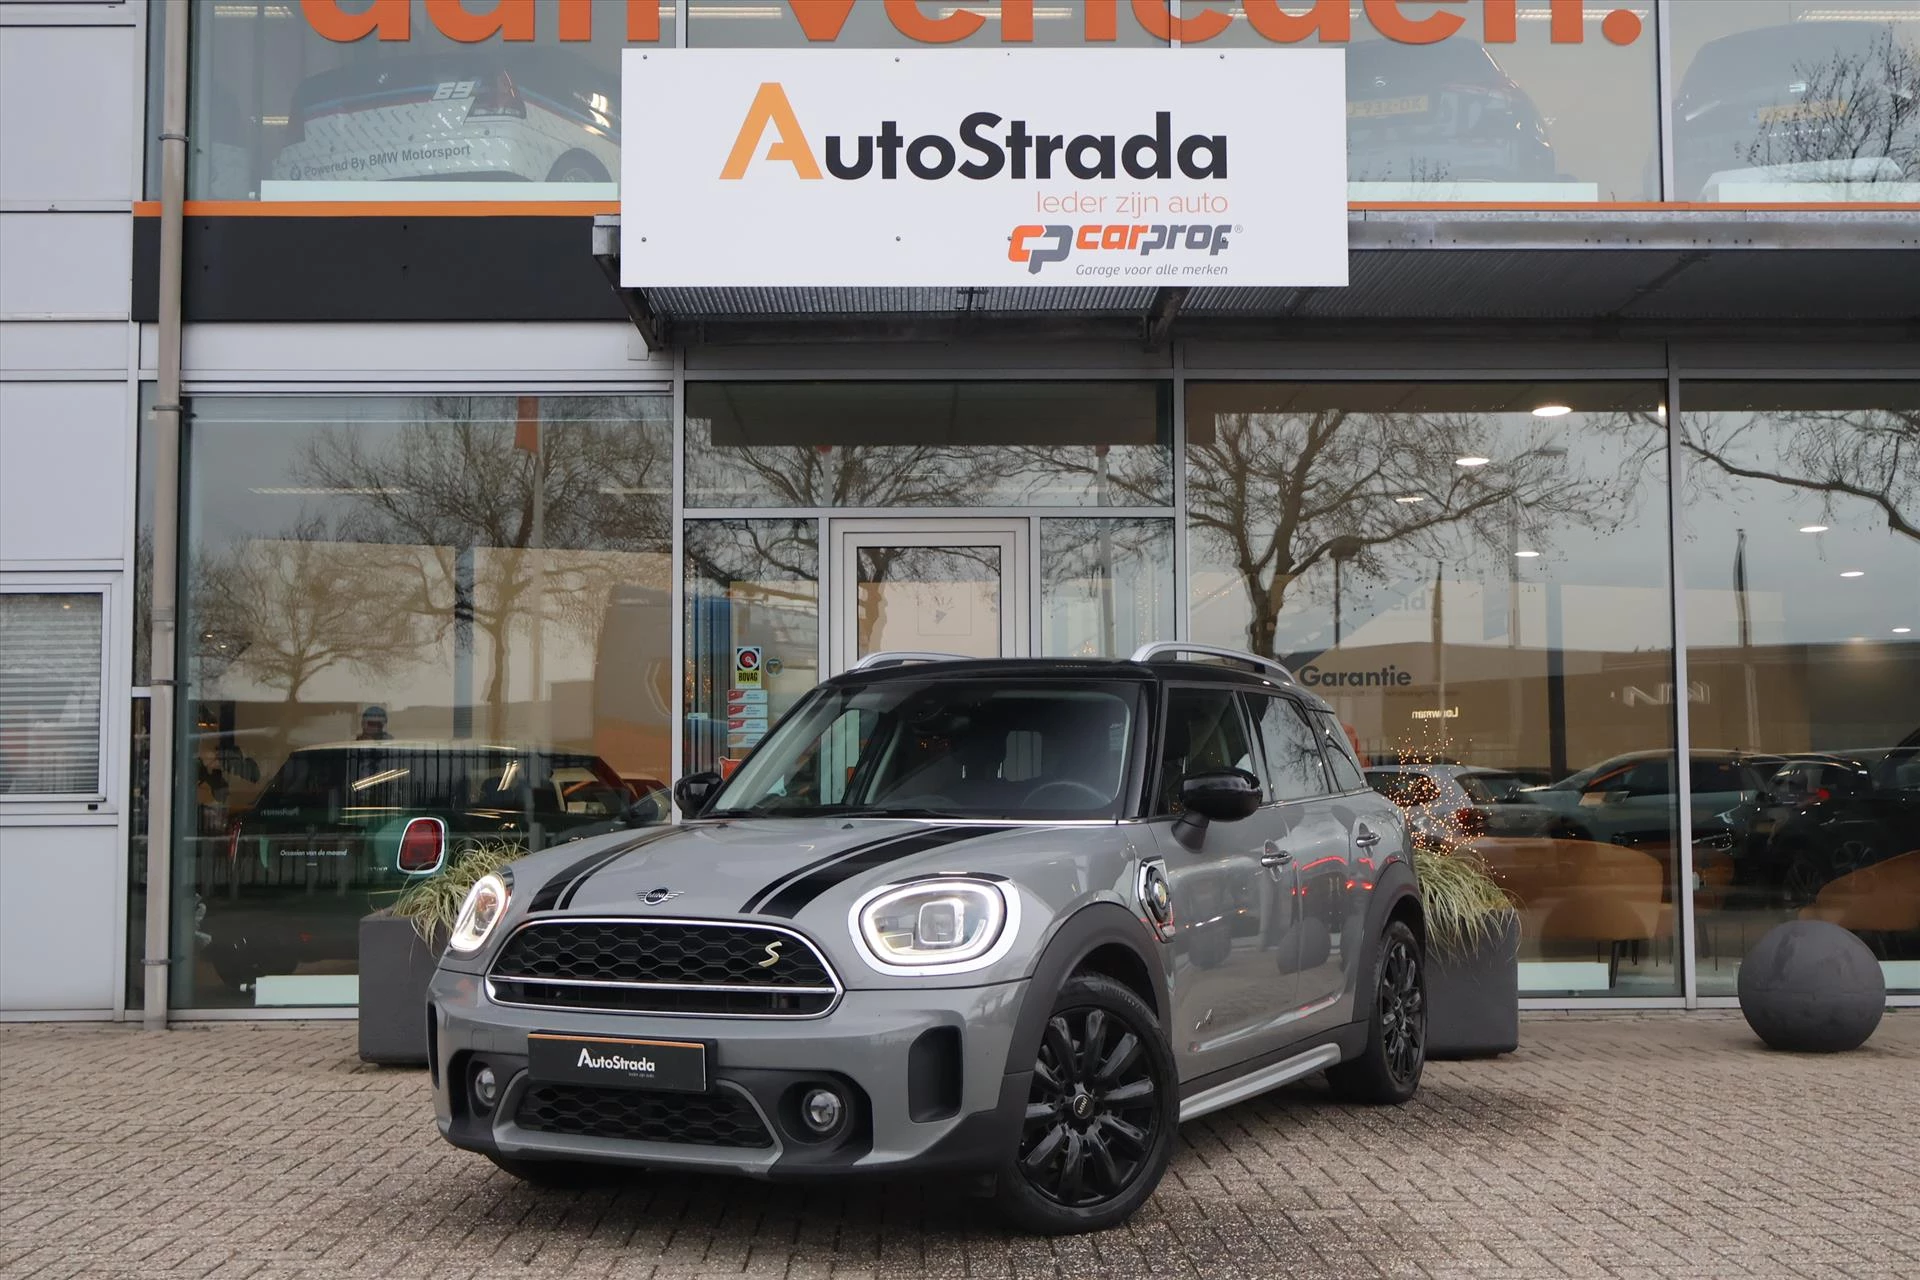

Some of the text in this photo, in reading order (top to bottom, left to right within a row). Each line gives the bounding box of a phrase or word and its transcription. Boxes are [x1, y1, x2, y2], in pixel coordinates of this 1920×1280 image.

[432, 81, 476, 100] 69
[719, 82, 1227, 180] AutoStrada
[303, 144, 471, 177] Powered By BMW Motorsport
[1036, 191, 1228, 219] Ieder zijn auto
[1076, 264, 1228, 278] Garage voor alle merken
[738, 672, 758, 682] BOVAG
[1299, 664, 1412, 687] Garantie
[317, 848, 326, 857] de
[758, 941, 783, 967] S
[577, 1047, 655, 1072] AutoStrada
